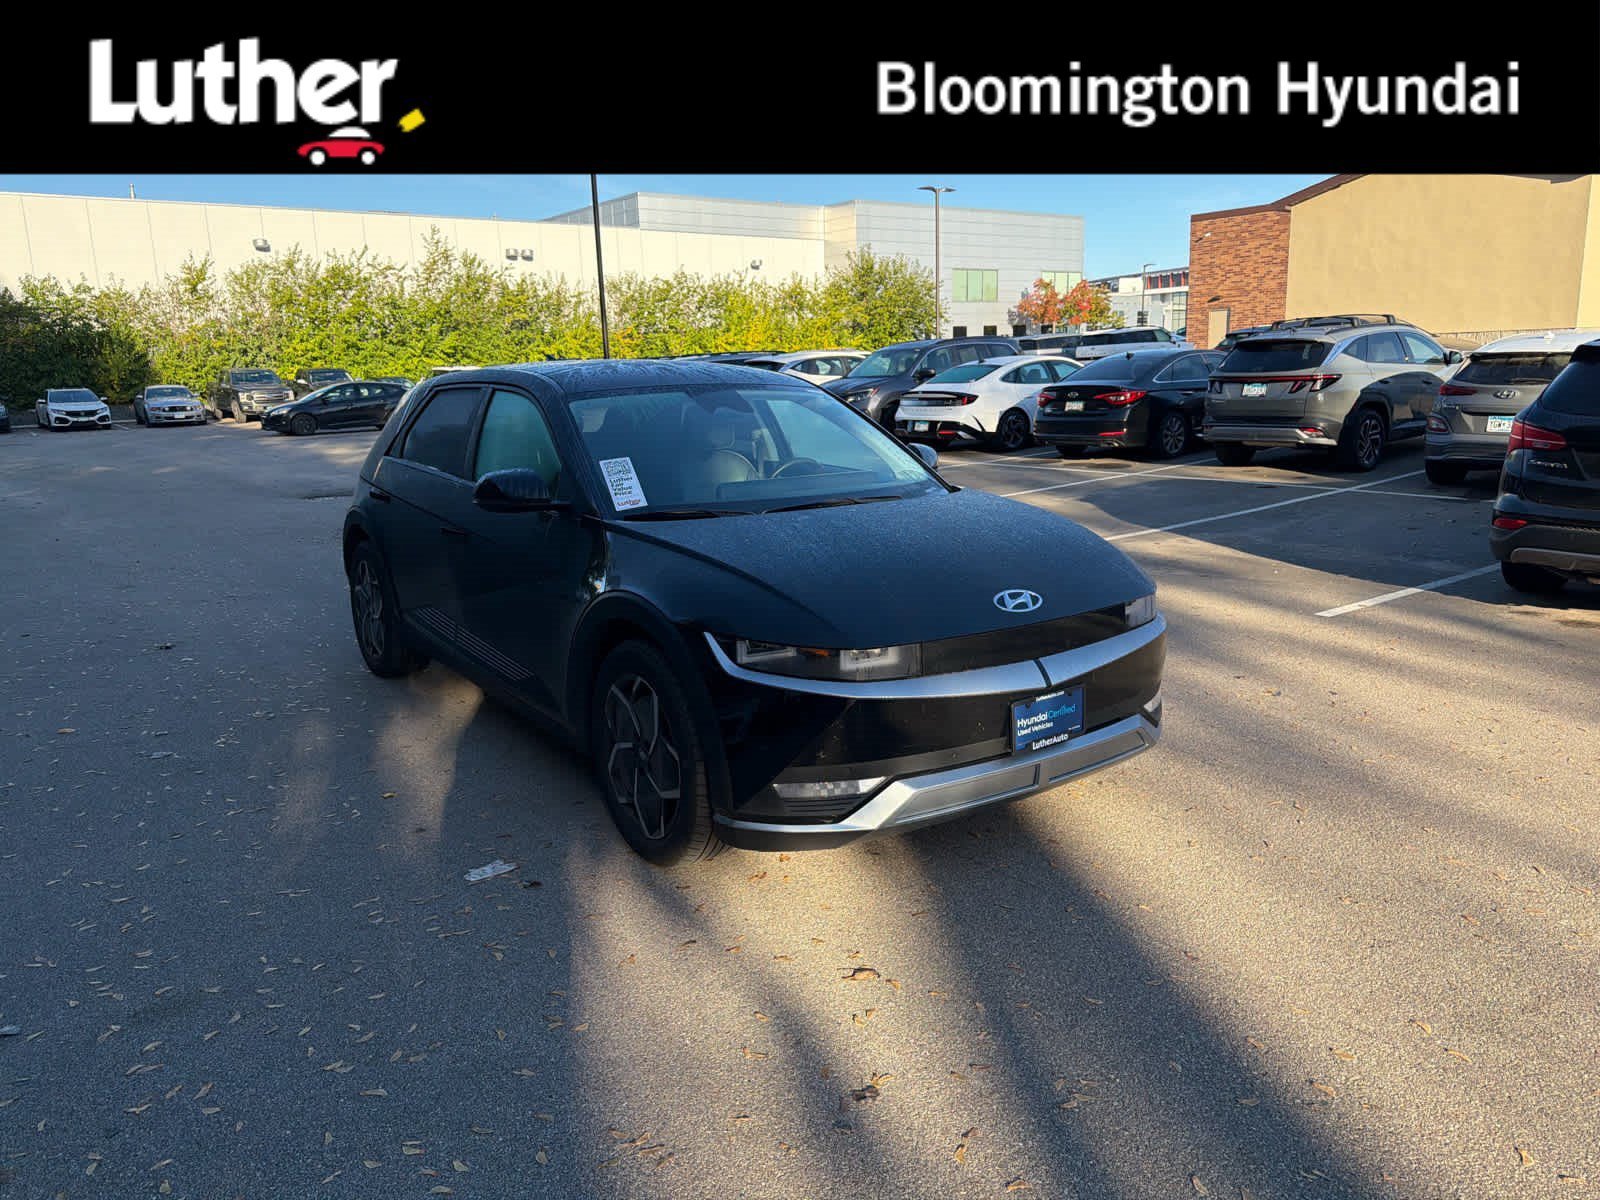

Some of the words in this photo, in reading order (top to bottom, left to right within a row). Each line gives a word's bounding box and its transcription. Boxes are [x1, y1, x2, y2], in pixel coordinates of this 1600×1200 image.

[1017, 711, 1048, 728] Hyundai
[1047, 703, 1076, 720] Certified
[1017, 727, 1031, 737] Used
[1031, 721, 1054, 732] Vehicles
[1032, 733, 1069, 751] LutherAuto
